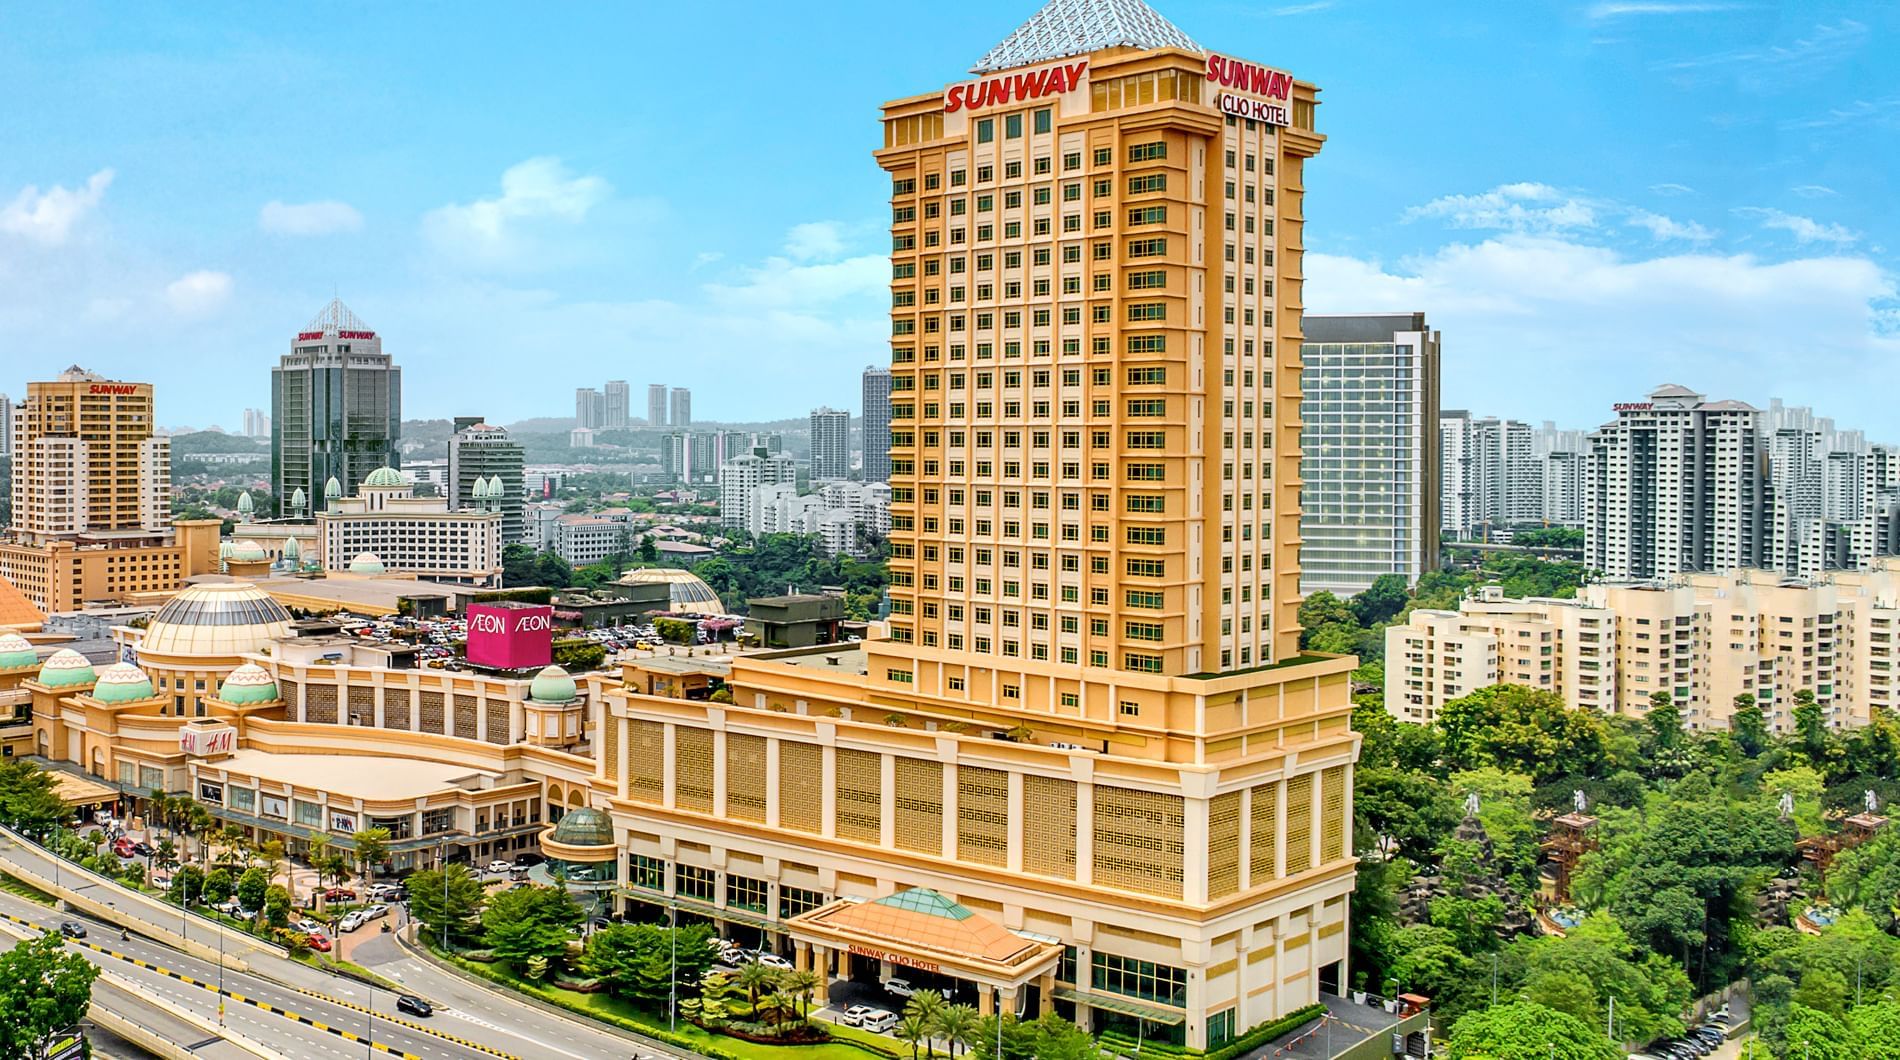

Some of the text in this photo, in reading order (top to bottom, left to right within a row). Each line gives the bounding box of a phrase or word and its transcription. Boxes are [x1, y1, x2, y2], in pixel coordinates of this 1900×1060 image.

[944, 61, 1089, 113] SUNWAY
[1206, 54, 1293, 101] SUNWAY
[1222, 94, 1290, 125] CLIO HOTEL
[338, 330, 375, 341] SUNWAY
[89, 384, 137, 395] SUNWAY
[1612, 402, 1655, 412] SUNWAY
[848, 944, 940, 973] SUNWAY CLIO HOTEL
